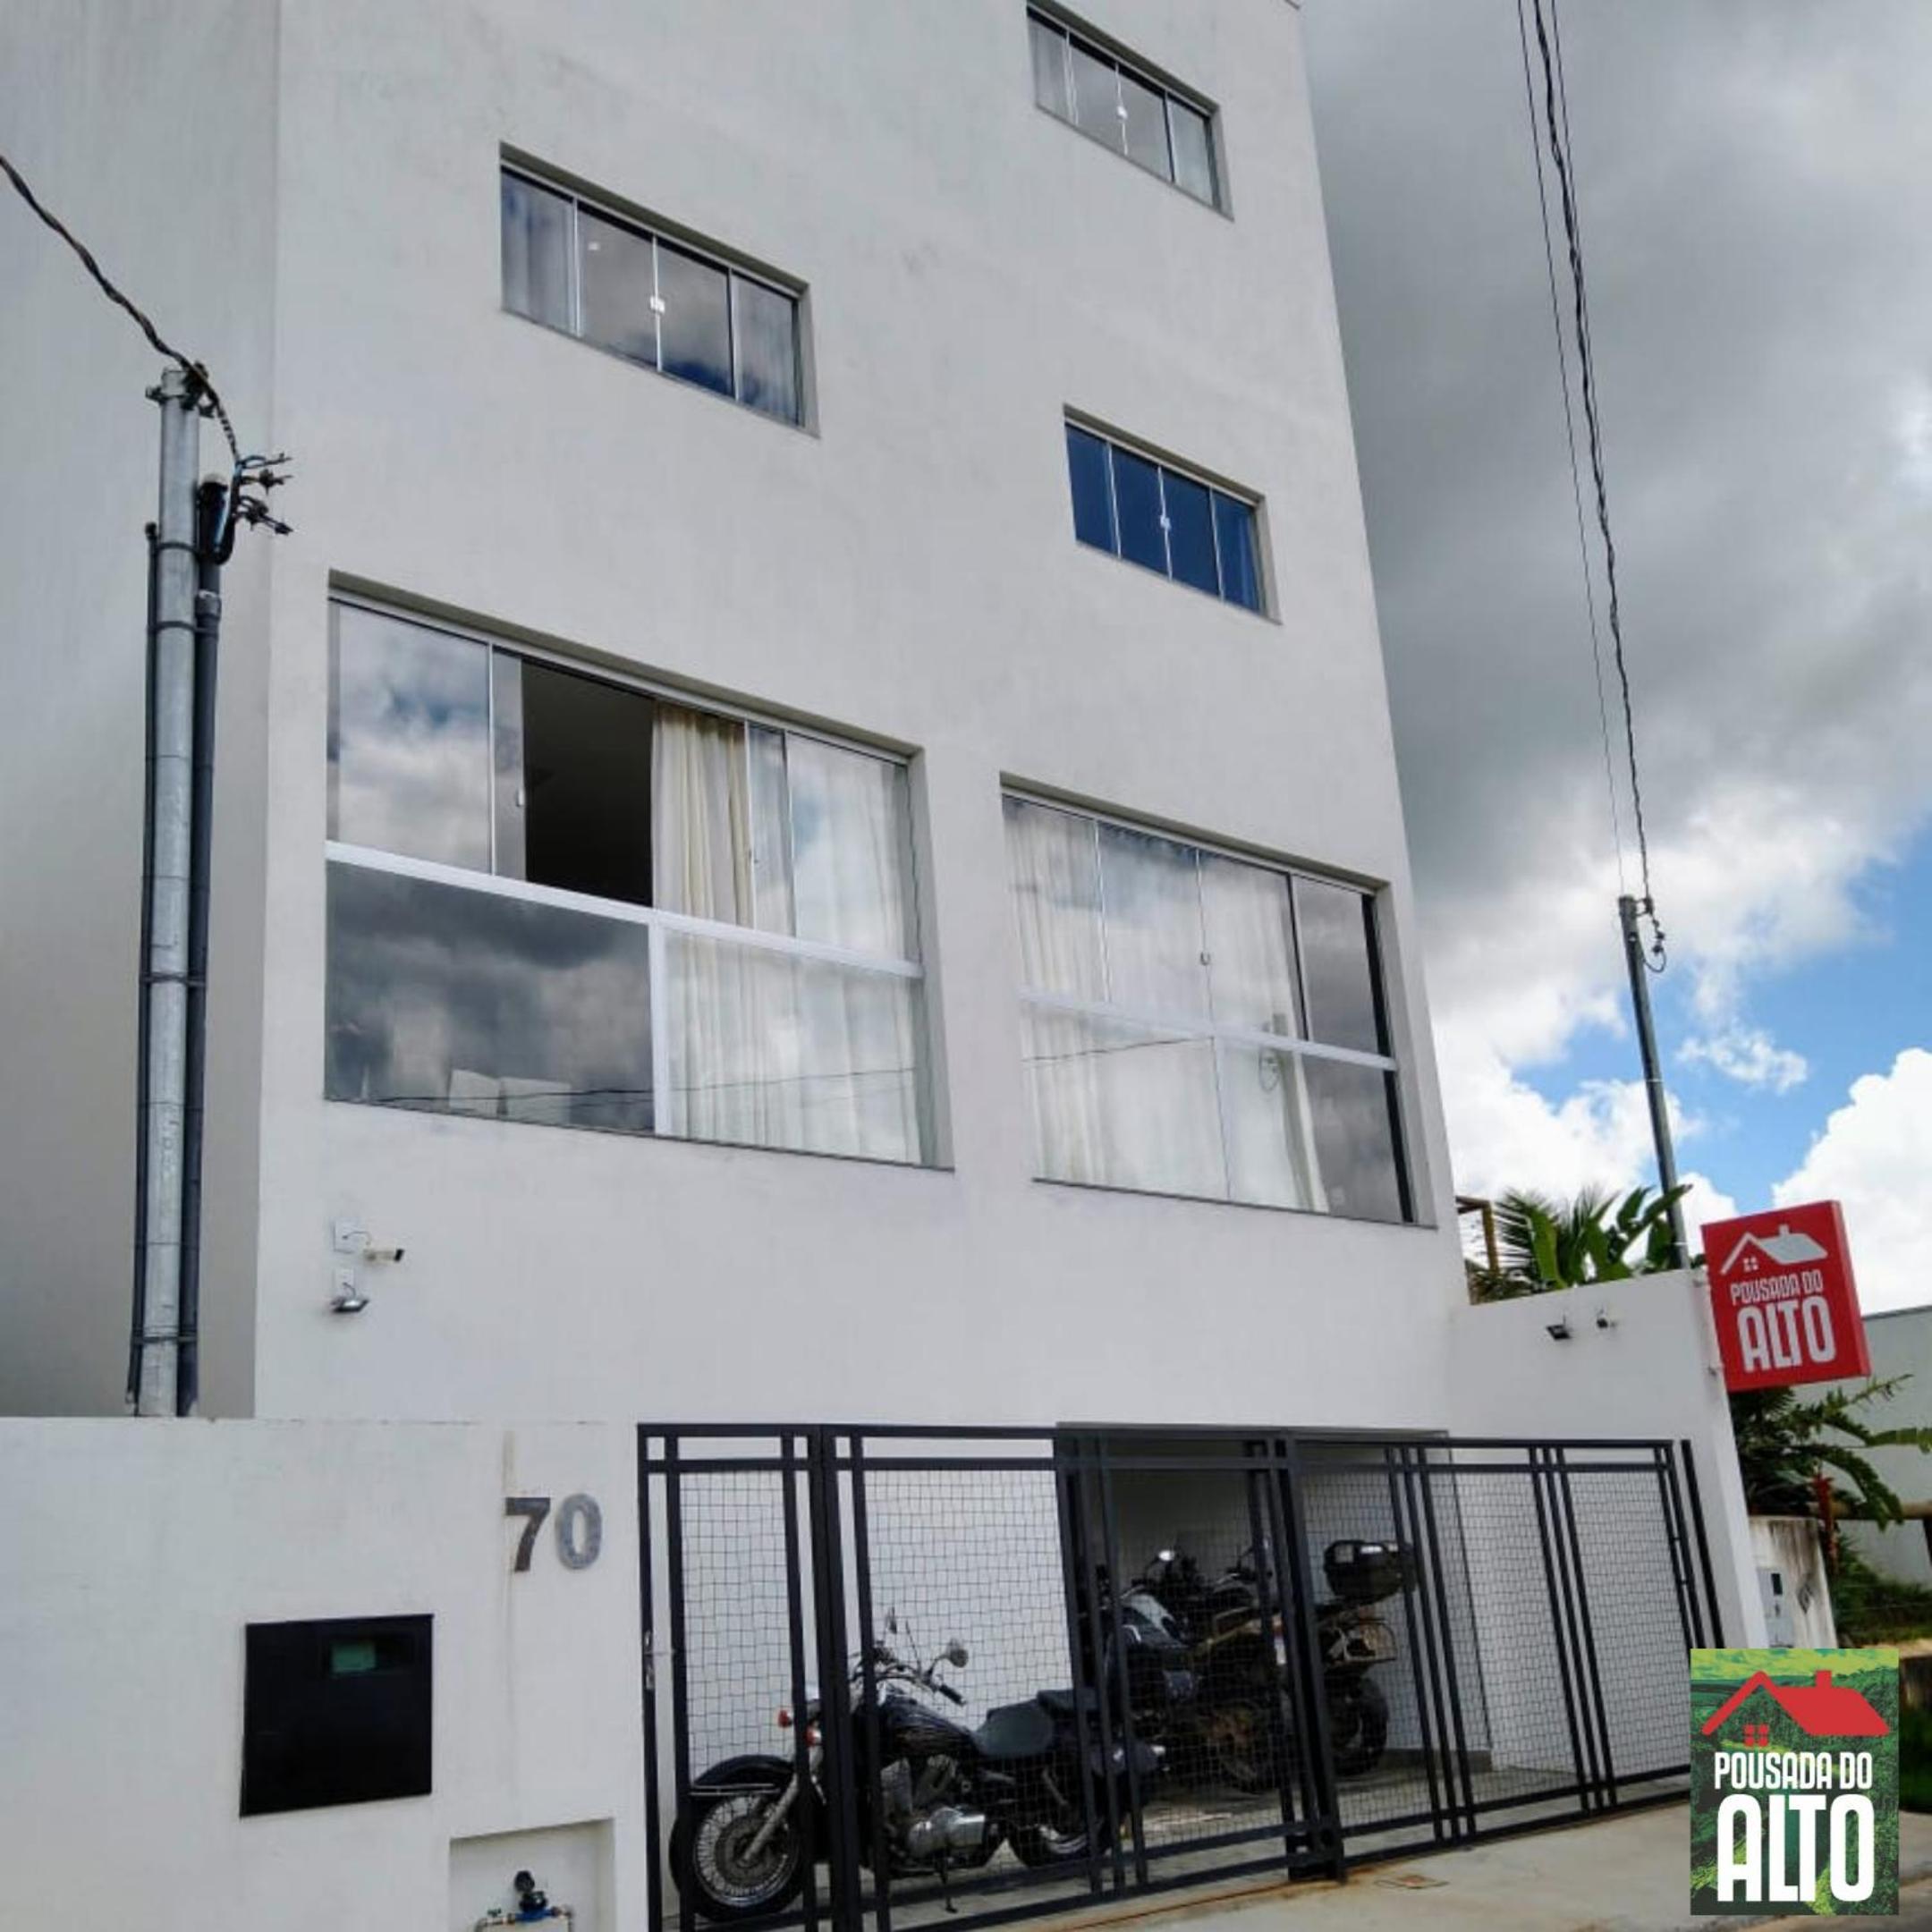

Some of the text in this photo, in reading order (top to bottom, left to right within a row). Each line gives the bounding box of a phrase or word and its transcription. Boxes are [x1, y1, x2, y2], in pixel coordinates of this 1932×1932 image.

[1730, 1269, 1824, 1306] POUSADA DO
[1737, 1296, 1836, 1372] ALTO
[504, 1493, 602, 1572] 70
